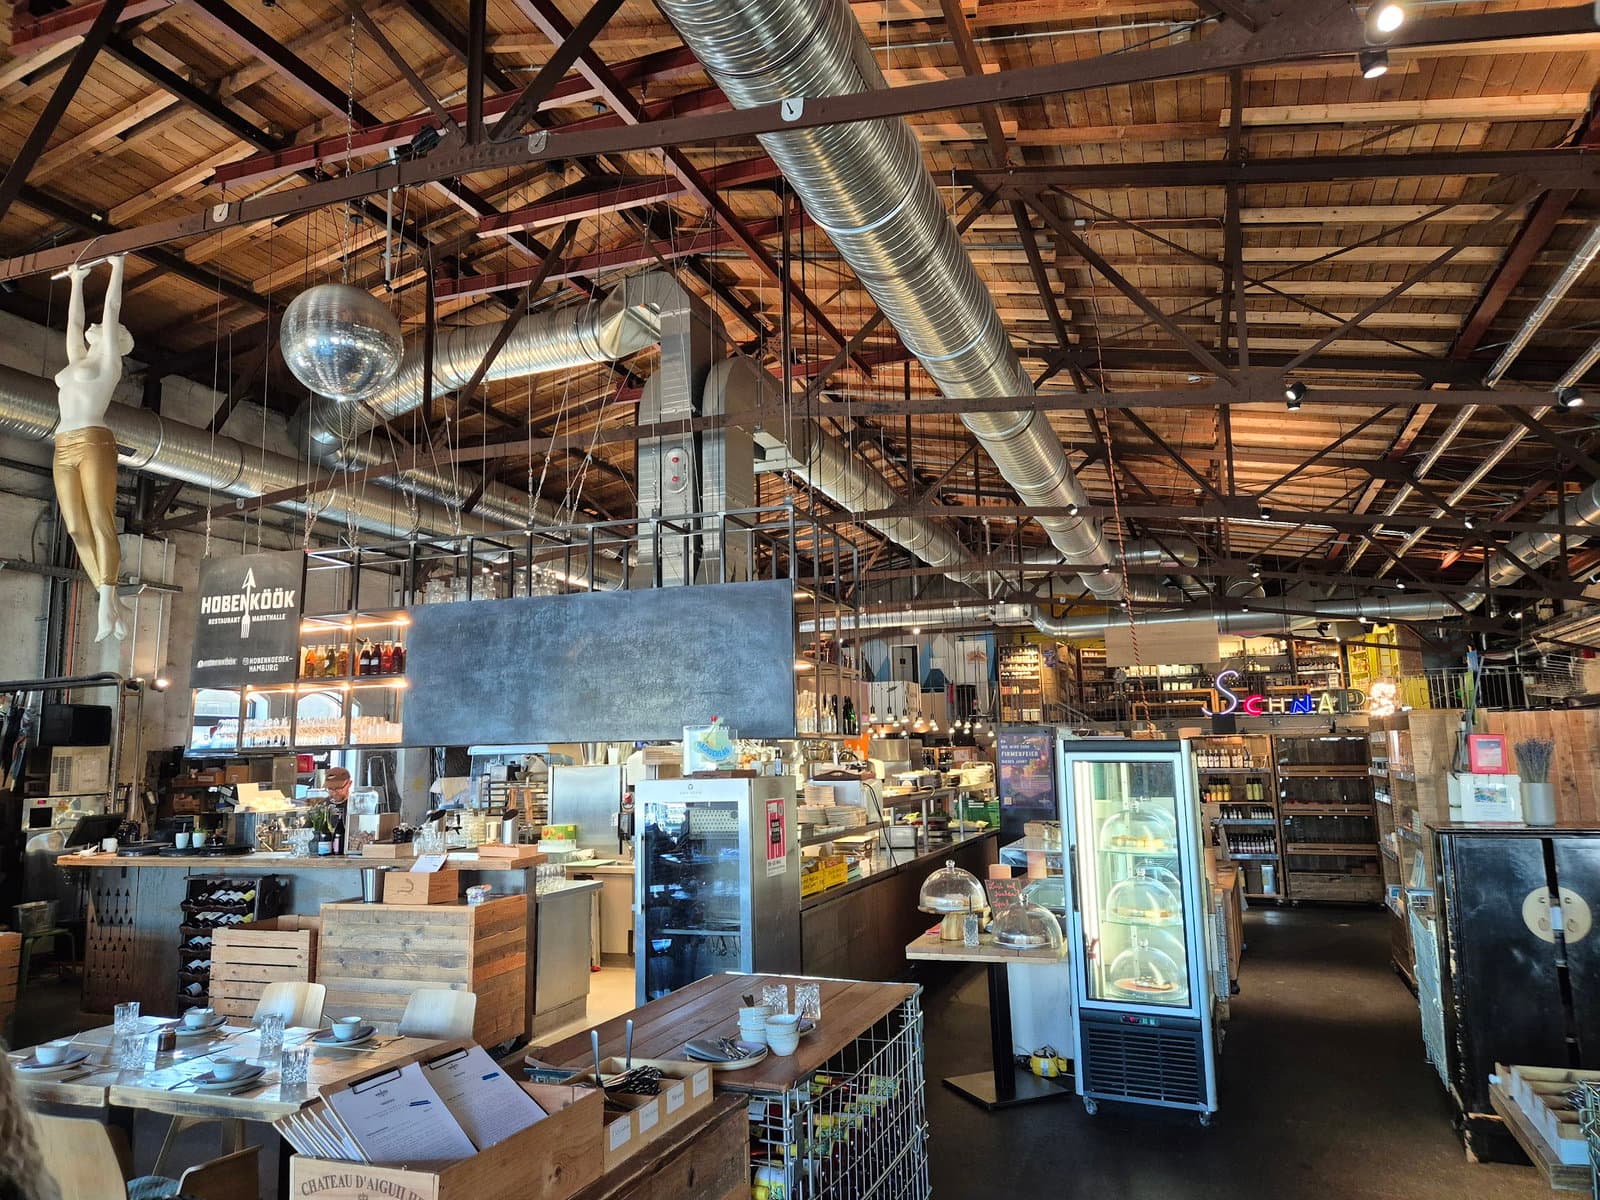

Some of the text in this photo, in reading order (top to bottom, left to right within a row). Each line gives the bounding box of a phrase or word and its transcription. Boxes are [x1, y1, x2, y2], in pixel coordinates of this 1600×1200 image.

[201, 588, 296, 615] HOBENKÖÖK
[208, 613, 286, 625] RESTAURANT MARKTHALLE
[248, 663, 279, 673] HAMBURG
[301, 1174, 425, 1200] CHATEAU D'AIGUILH
